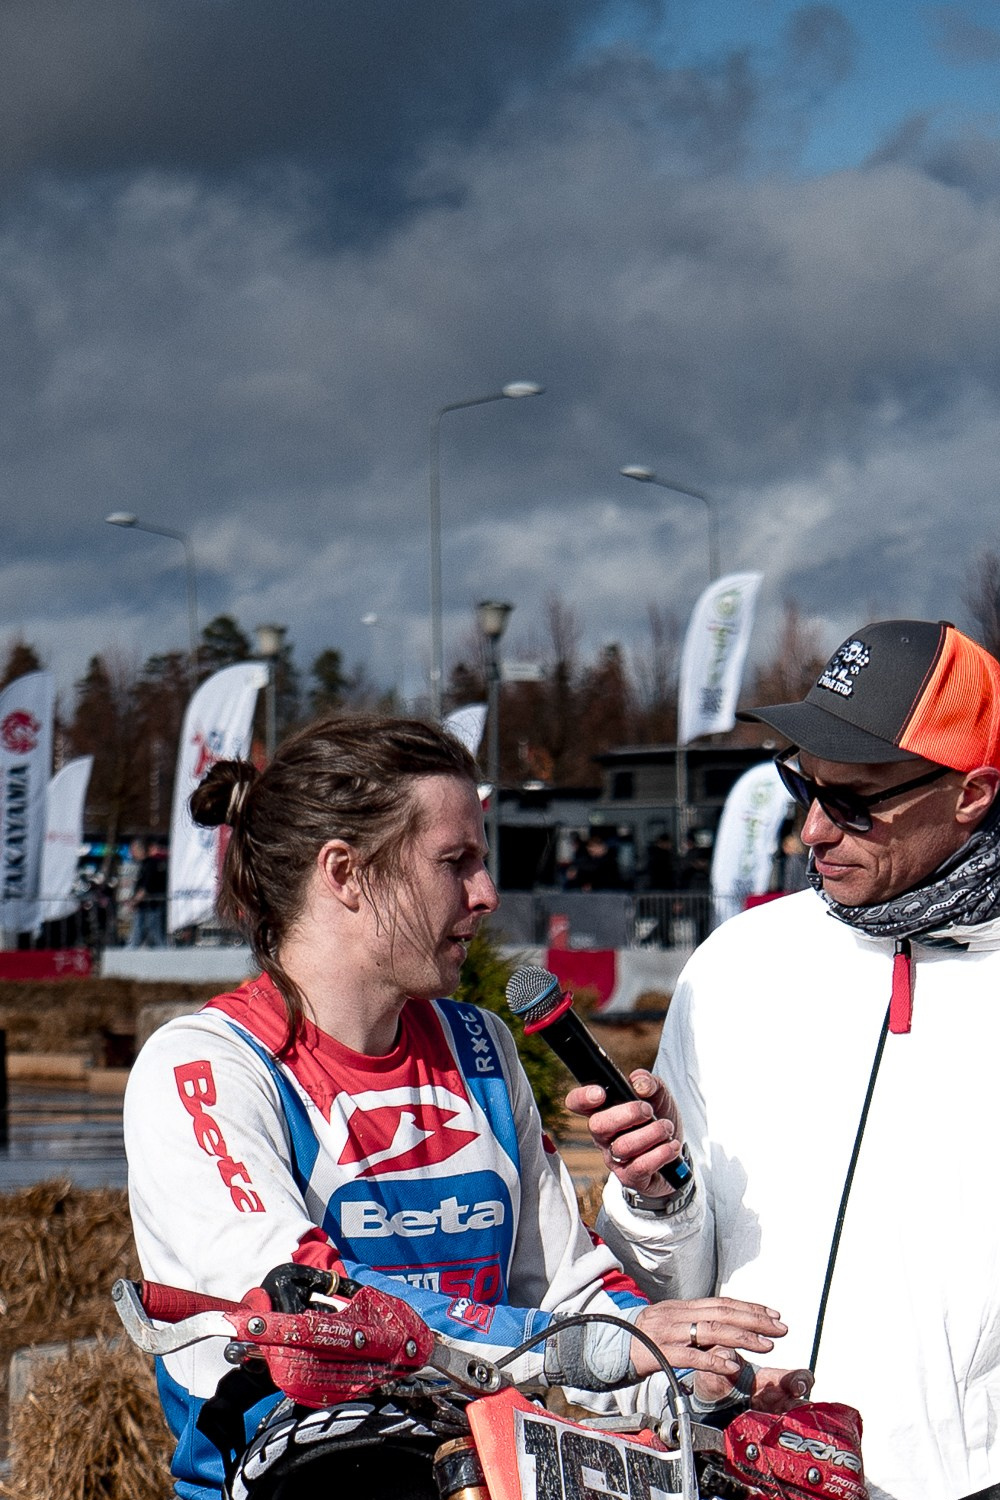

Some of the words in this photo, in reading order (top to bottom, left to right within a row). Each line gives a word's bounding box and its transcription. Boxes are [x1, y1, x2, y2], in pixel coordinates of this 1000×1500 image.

[3, 763, 29, 900] TAKAYAMA
[174, 1060, 267, 1213] Beta
[340, 1197, 504, 1238] Beta
